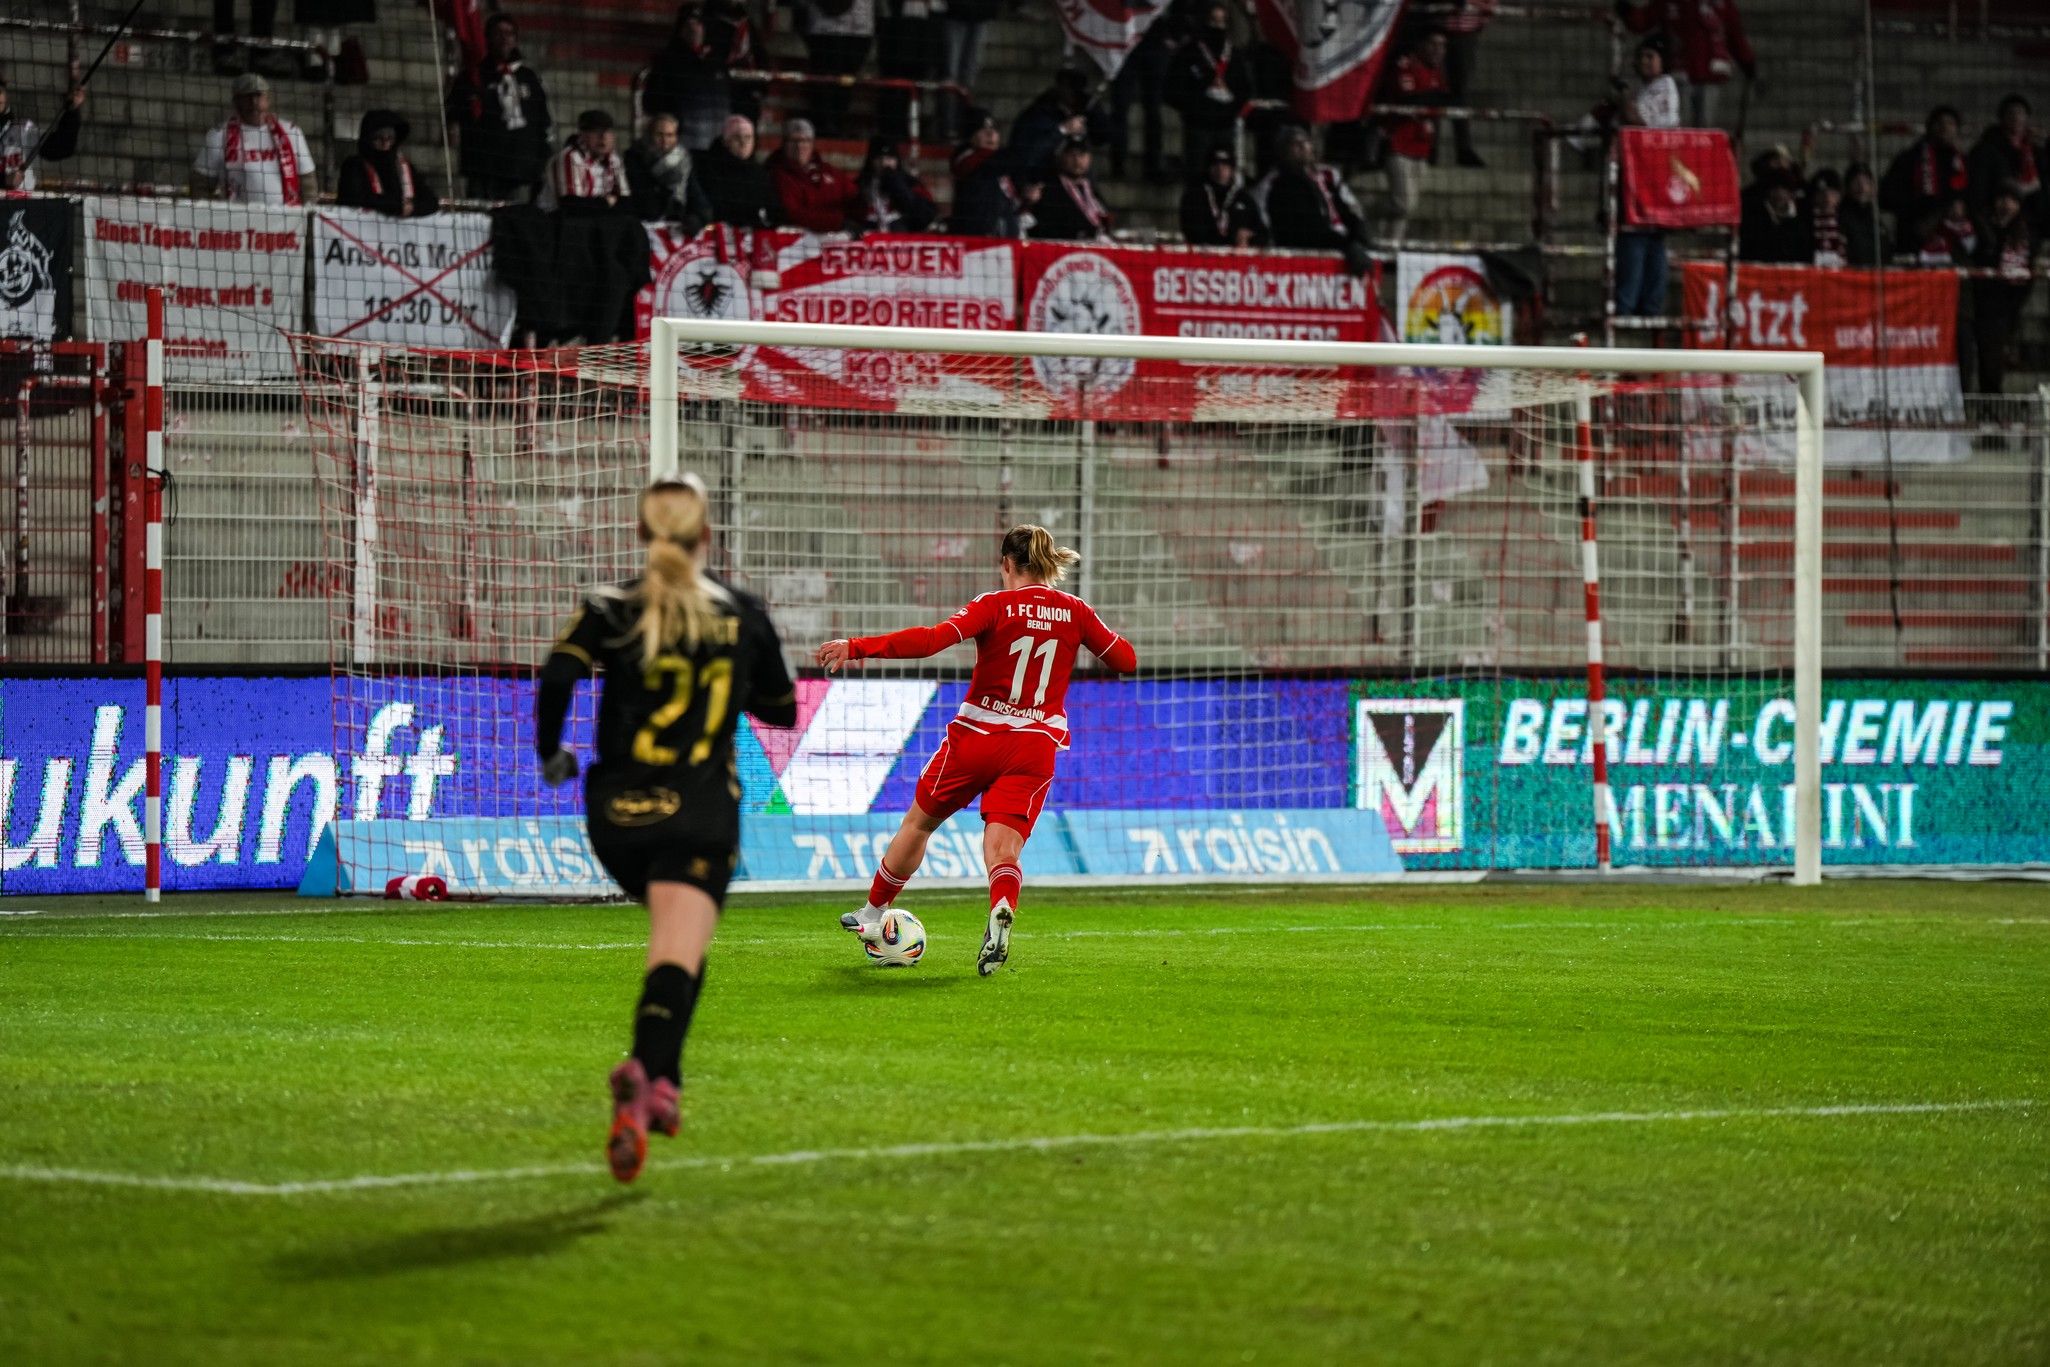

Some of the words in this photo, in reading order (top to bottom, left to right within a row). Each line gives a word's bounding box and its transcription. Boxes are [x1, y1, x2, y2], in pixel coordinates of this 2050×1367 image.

[822, 243, 963, 277] FRAUEN
[1153, 264, 1368, 310] GEISSBÖCKINNEN
[777, 297, 1003, 330] SUPPORTERS
[1006, 604, 1015, 618] 1.
[1018, 603, 1033, 618] FC
[1037, 605, 1071, 622] UNION
[1027, 619, 1052, 631] BERLIN
[1009, 635, 1058, 708] 11
[631, 654, 734, 767] 21
[1500, 698, 2012, 766] BERLIN-CHEMIE
[1177, 813, 1341, 873] raisin
